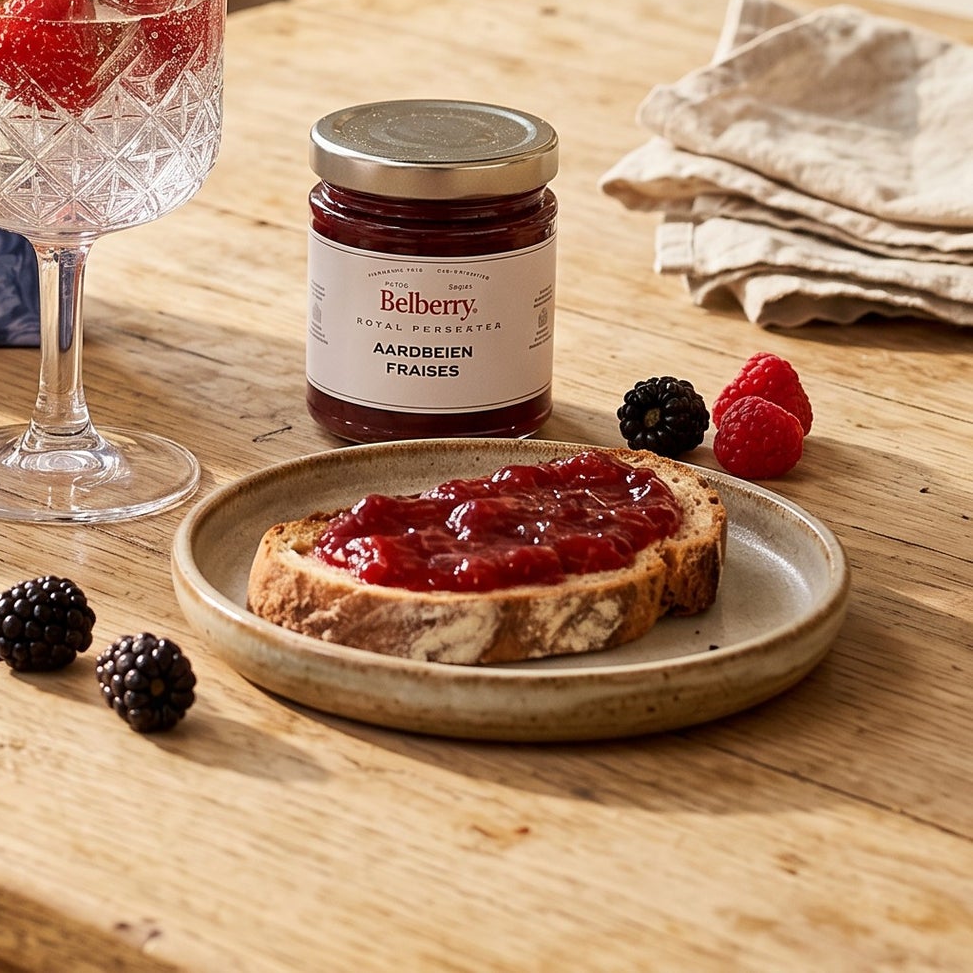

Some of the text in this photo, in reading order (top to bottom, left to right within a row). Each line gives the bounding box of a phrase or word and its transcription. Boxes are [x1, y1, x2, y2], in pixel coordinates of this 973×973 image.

[380, 289, 476, 321] Belberry
[356, 317, 403, 331] ROYAL
[373, 342, 473, 358] AARDBEIEN
[387, 362, 460, 377] FRAISES
